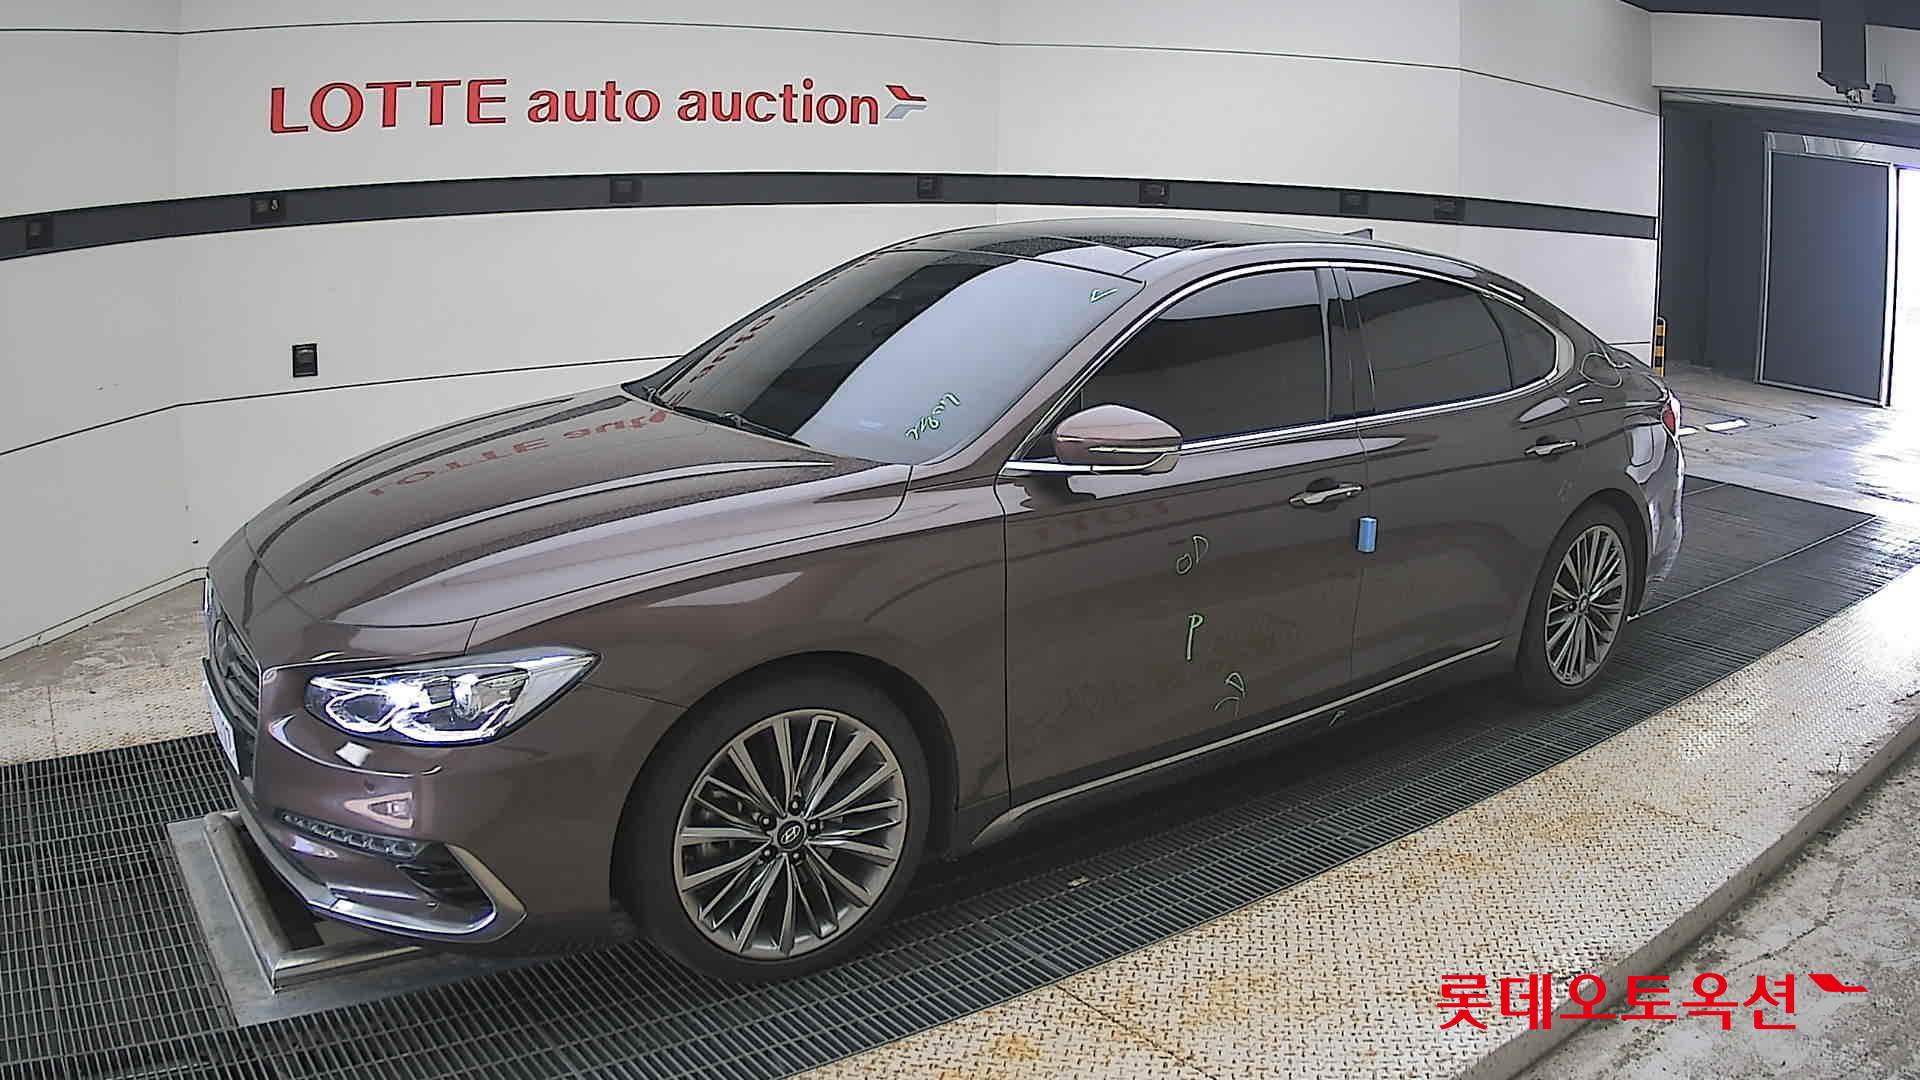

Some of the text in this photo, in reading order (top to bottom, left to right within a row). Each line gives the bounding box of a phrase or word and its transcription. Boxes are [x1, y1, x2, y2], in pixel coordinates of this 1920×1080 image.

[269, 78, 880, 134] LOTTE auto auction
